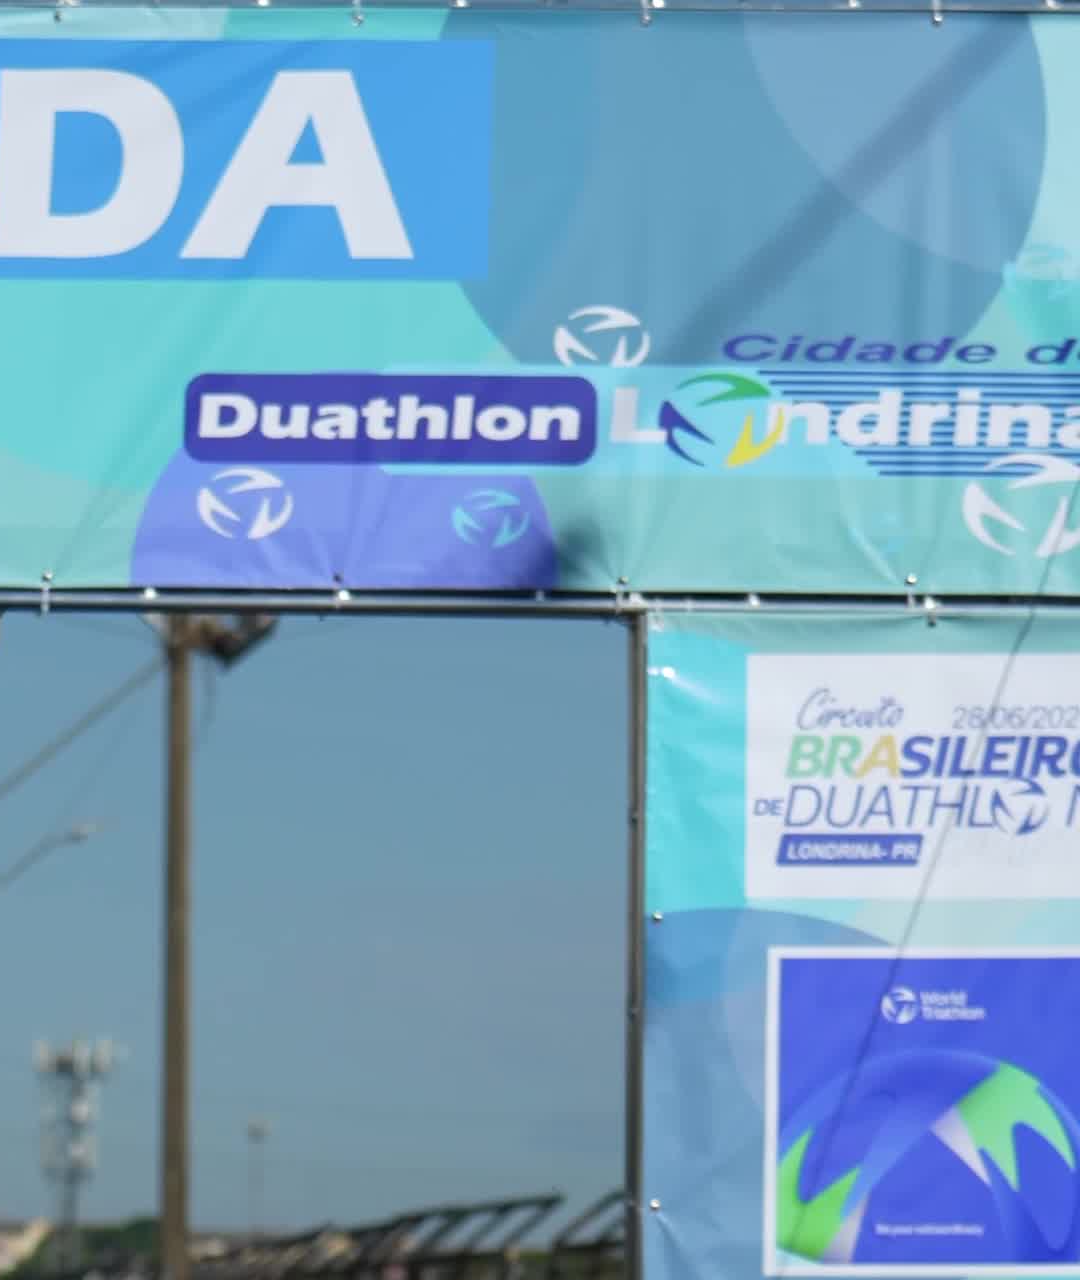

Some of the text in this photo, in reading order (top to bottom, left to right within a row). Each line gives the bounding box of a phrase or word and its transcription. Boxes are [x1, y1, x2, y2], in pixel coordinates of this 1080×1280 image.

[724, 334, 1080, 365] Cidade d
[197, 393, 582, 442] Duathlon
[784, 734, 1080, 779] BRASILEIR
[753, 798, 784, 817] DE
